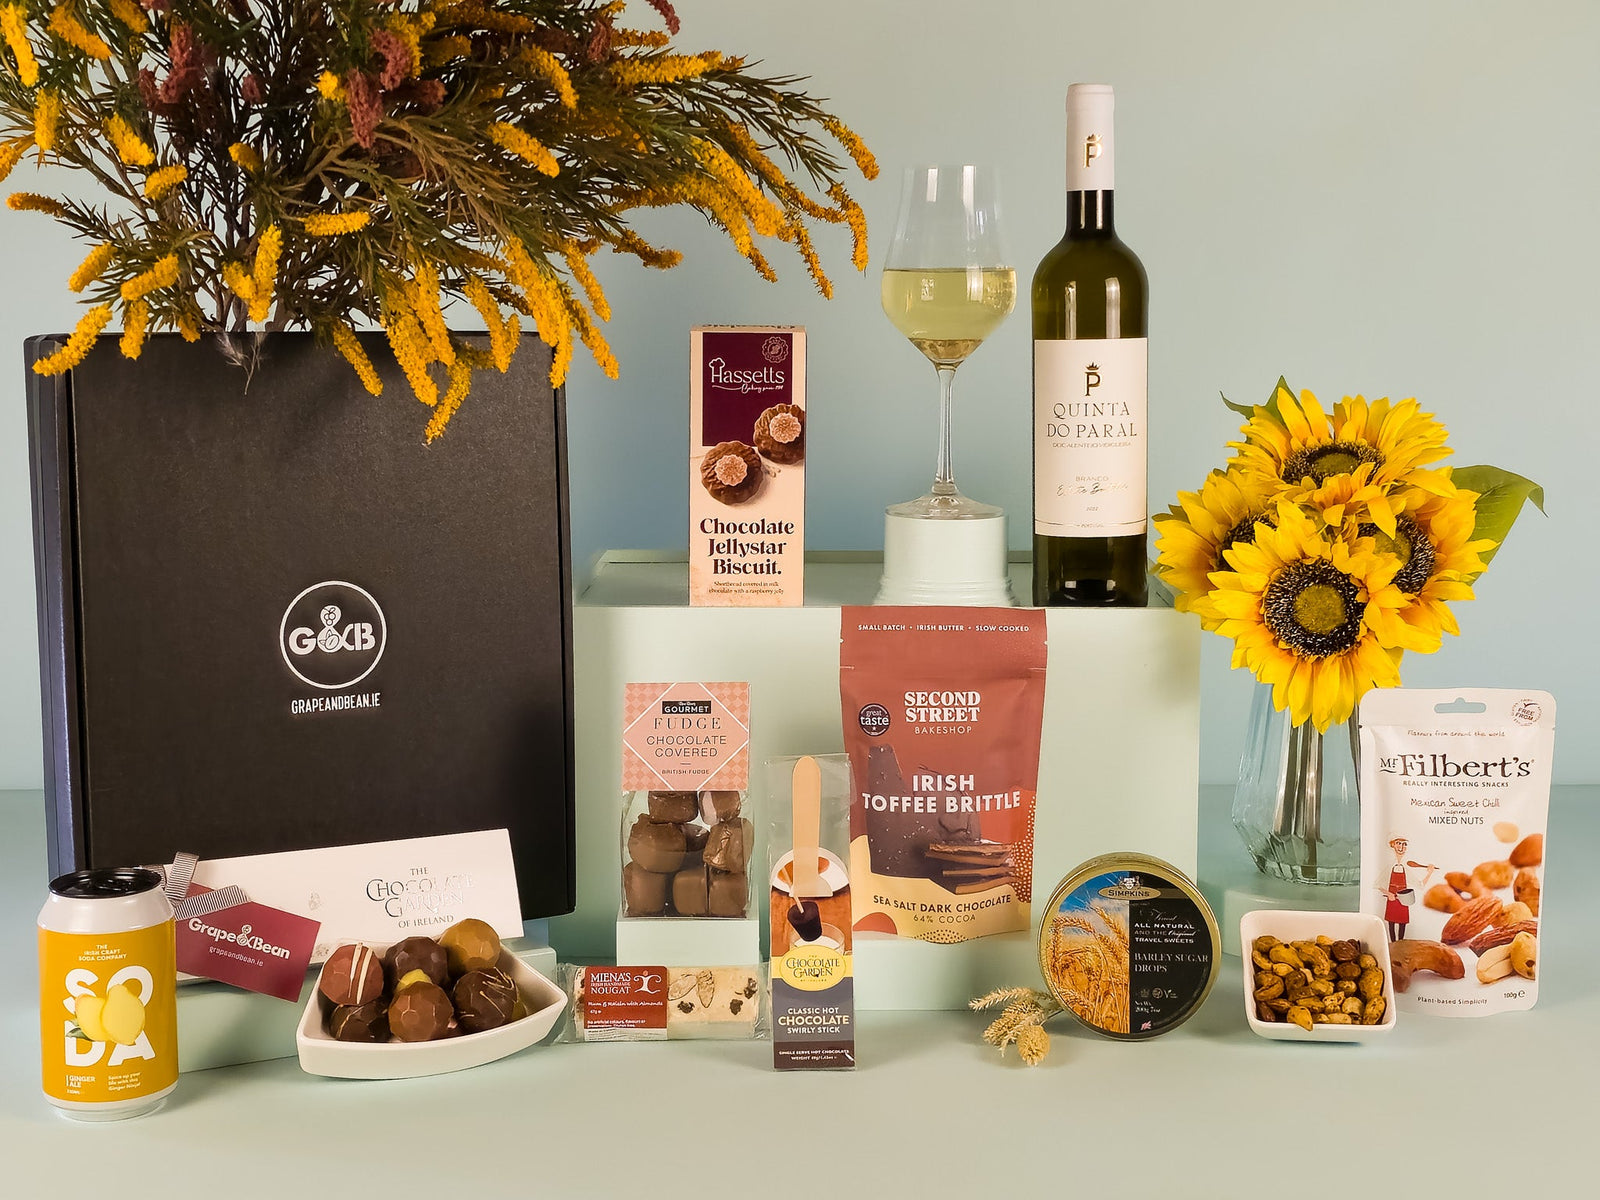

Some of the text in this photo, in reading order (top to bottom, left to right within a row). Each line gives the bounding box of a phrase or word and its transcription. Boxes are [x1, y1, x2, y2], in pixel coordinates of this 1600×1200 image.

[710, 361, 785, 383] Hassetts
[1085, 372, 1100, 396] P
[1053, 402, 1130, 419] QUINTA
[1047, 423, 1138, 438] DO PARAL
[700, 518, 794, 534] Chocolate
[708, 538, 786, 558] Jellystar
[713, 558, 782, 574] Biscuit.
[288, 605, 376, 655] G&B
[291, 692, 380, 714] GRAPEANDBEAN.IE
[904, 691, 981, 706] SECOND
[905, 707, 980, 723] STREET
[1515, 713, 1533, 721] FROM
[1518, 708, 1534, 716] FREE
[654, 718, 721, 729] FUDGE
[860, 716, 889, 725] taste
[914, 726, 972, 734] BAKESHOP
[646, 736, 726, 745] CHOCOLATE
[655, 748, 718, 757] COVERED
[1398, 754, 1531, 778] Filbert's
[913, 774, 974, 791] IRISH
[862, 791, 1020, 813] TOFFEE BRITTLE
[1411, 798, 1446, 808] Mexican
[1449, 798, 1479, 808] Sweet
[410, 867, 429, 876] THE
[366, 874, 474, 902] CHOCOLATE
[1108, 889, 1150, 897] SIMPKINS
[385, 890, 464, 918] GARDEN
[873, 894, 1012, 913] SEA SALT DARK CHOCOLATE
[398, 915, 454, 928] OF IRELAND
[913, 914, 976, 923] 64% COCOA
[208, 946, 264, 967] grapeandbean.ie
[1175, 953, 1208, 962] SUGAR
[786, 958, 840, 969] CHOCOLATE
[1134, 964, 1167, 972] DROPS
[590, 973, 631, 982] MIENA'S
[793, 968, 832, 978] GARDEN
[1417, 996, 1456, 1005] Plant-based
[778, 1015, 850, 1025] CHOCOLATE
